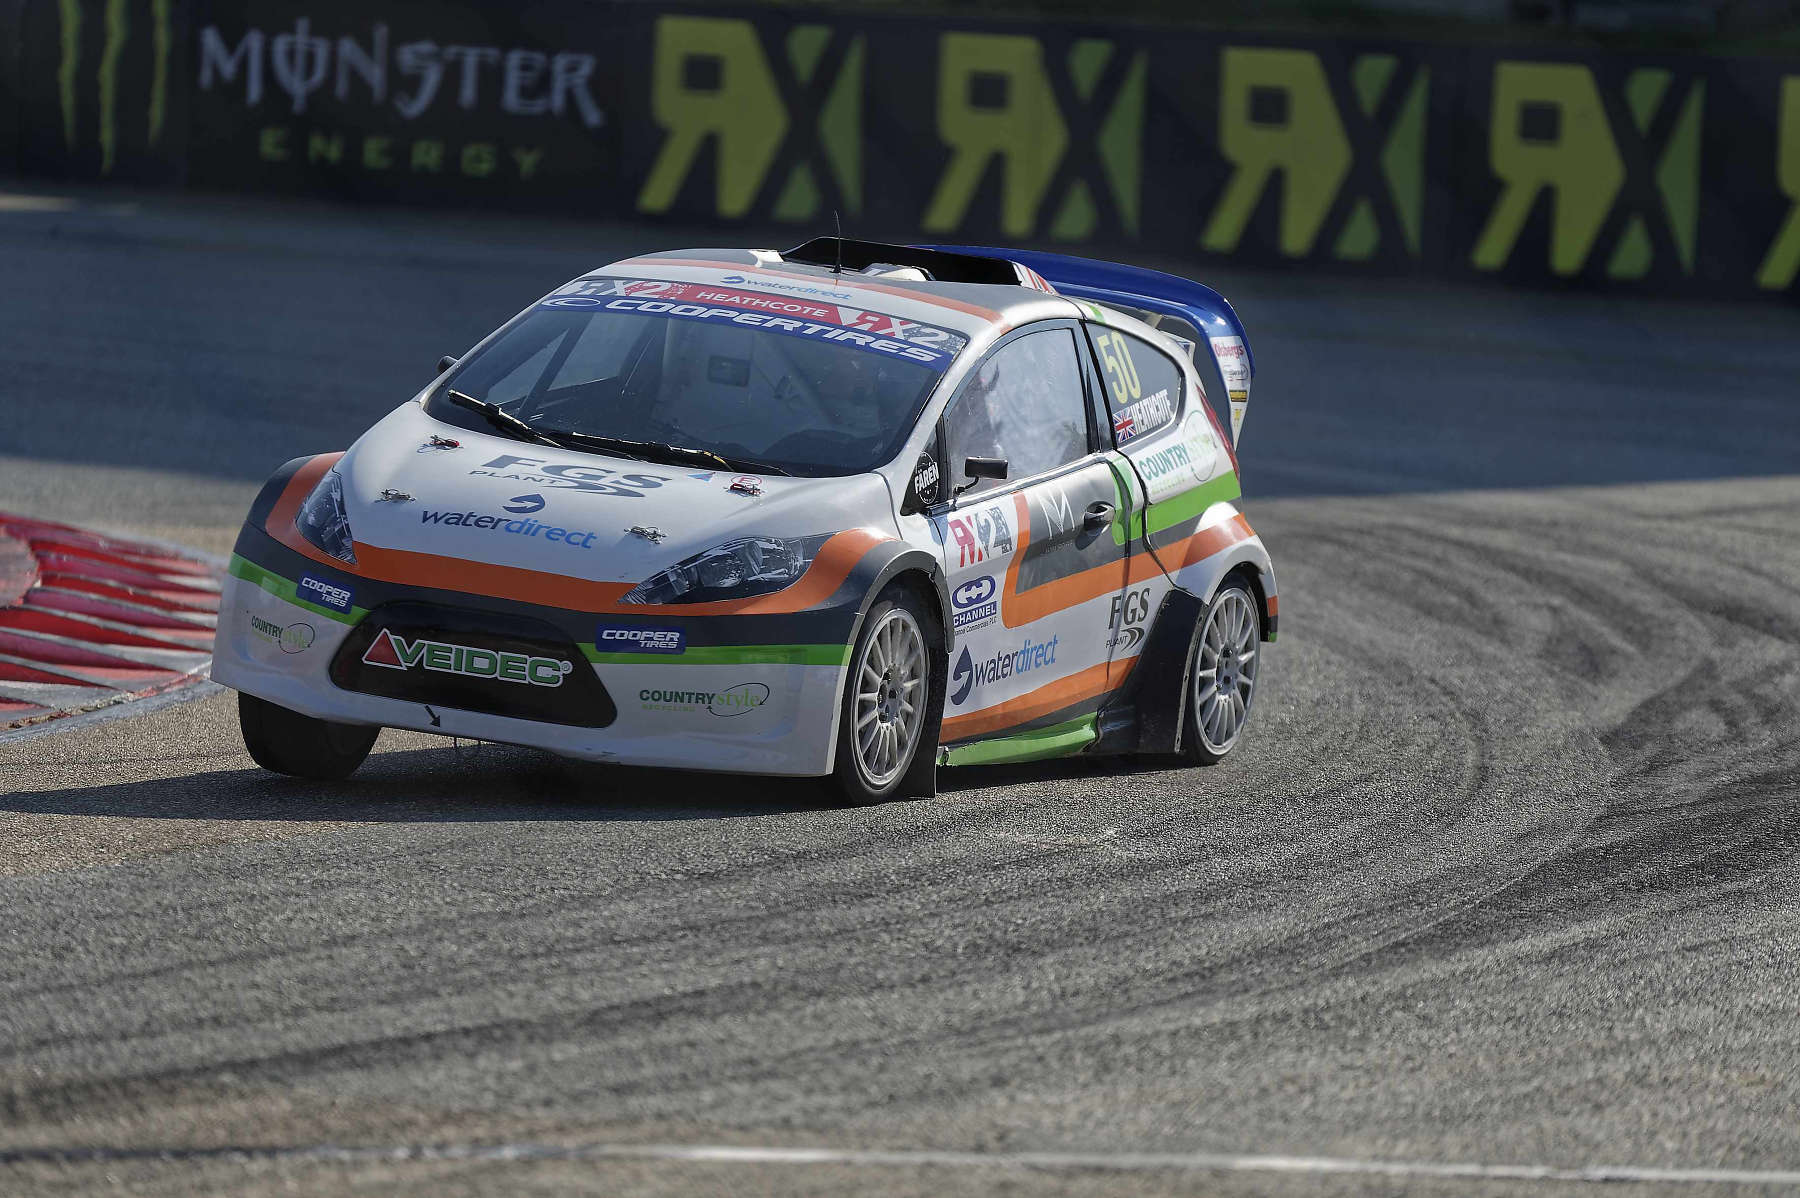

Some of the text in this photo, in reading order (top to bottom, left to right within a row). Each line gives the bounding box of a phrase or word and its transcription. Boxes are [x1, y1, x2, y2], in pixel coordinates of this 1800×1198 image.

[199, 18, 605, 128] MONSTER
[258, 126, 543, 180] ENERGY
[746, 278, 851, 300] waterdirect
[696, 291, 829, 318] HEATHCOTE
[1097, 330, 1141, 404] 50
[469, 470, 558, 486] PLANT
[483, 454, 671, 490] FGS
[422, 510, 598, 549] waterdirect
[301, 577, 351, 601] COOPER
[321, 593, 347, 607] TIRES
[953, 604, 996, 626] CHANNEL
[1108, 588, 1151, 630] FGS
[601, 629, 680, 642] COOPER
[639, 640, 678, 649] TIRES
[1105, 635, 1129, 649] PLANT
[974, 634, 1058, 688] waterdirect
